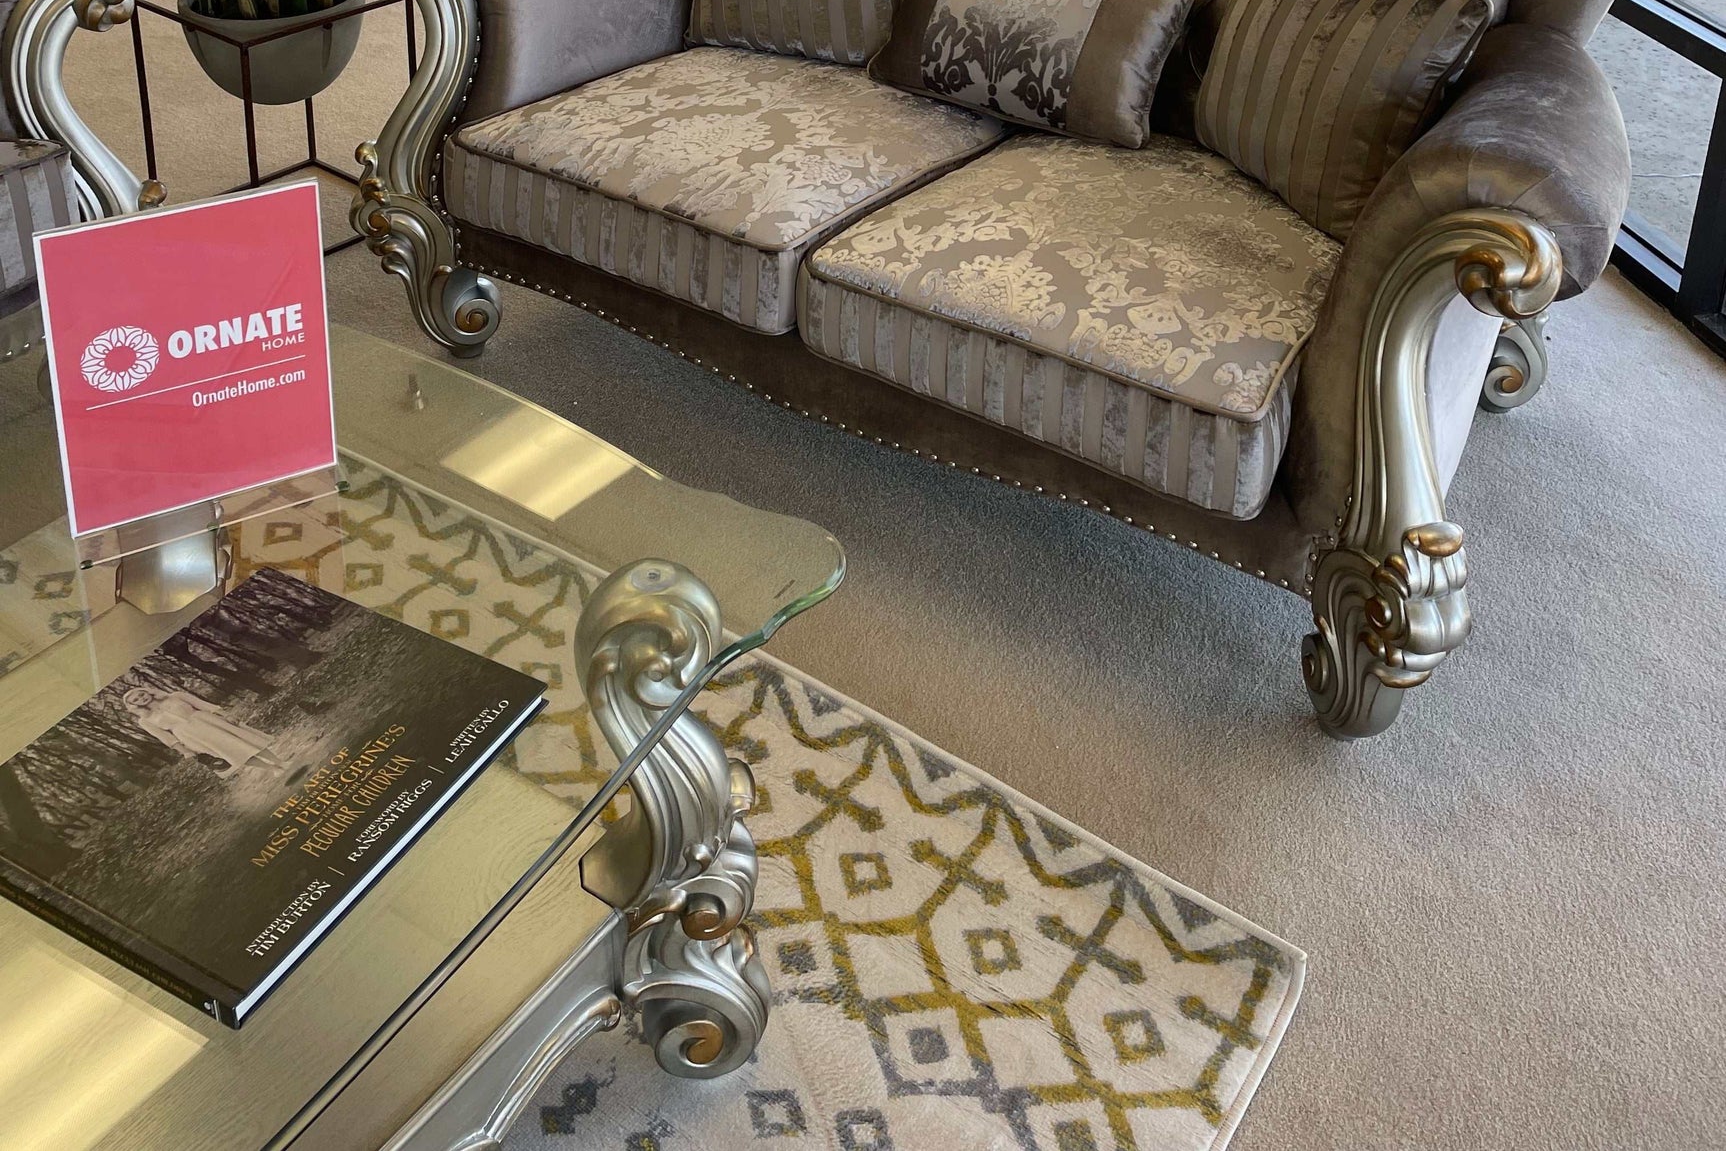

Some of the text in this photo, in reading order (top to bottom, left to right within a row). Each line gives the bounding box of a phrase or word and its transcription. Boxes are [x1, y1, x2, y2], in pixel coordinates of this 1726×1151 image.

[167, 303, 303, 359] ORNATE
[262, 332, 305, 352] HOME
[192, 369, 306, 407] OrnateHome.com
[445, 700, 509, 763] LEAH GALLO
[449, 707, 490, 746] WRITTEN BY
[250, 724, 405, 867] MISS PEREGRINE'S
[270, 793, 303, 818] THE
[304, 765, 330, 793] ART
[331, 746, 349, 765] OF
[300, 754, 416, 858] PECULIAR CHILDREN
[355, 788, 409, 842] FOREWORD BY
[347, 778, 433, 862] RANSOM RIGGS
[246, 878, 320, 952] INTRODUCTION BY
[251, 881, 332, 956] TIM BURTON
